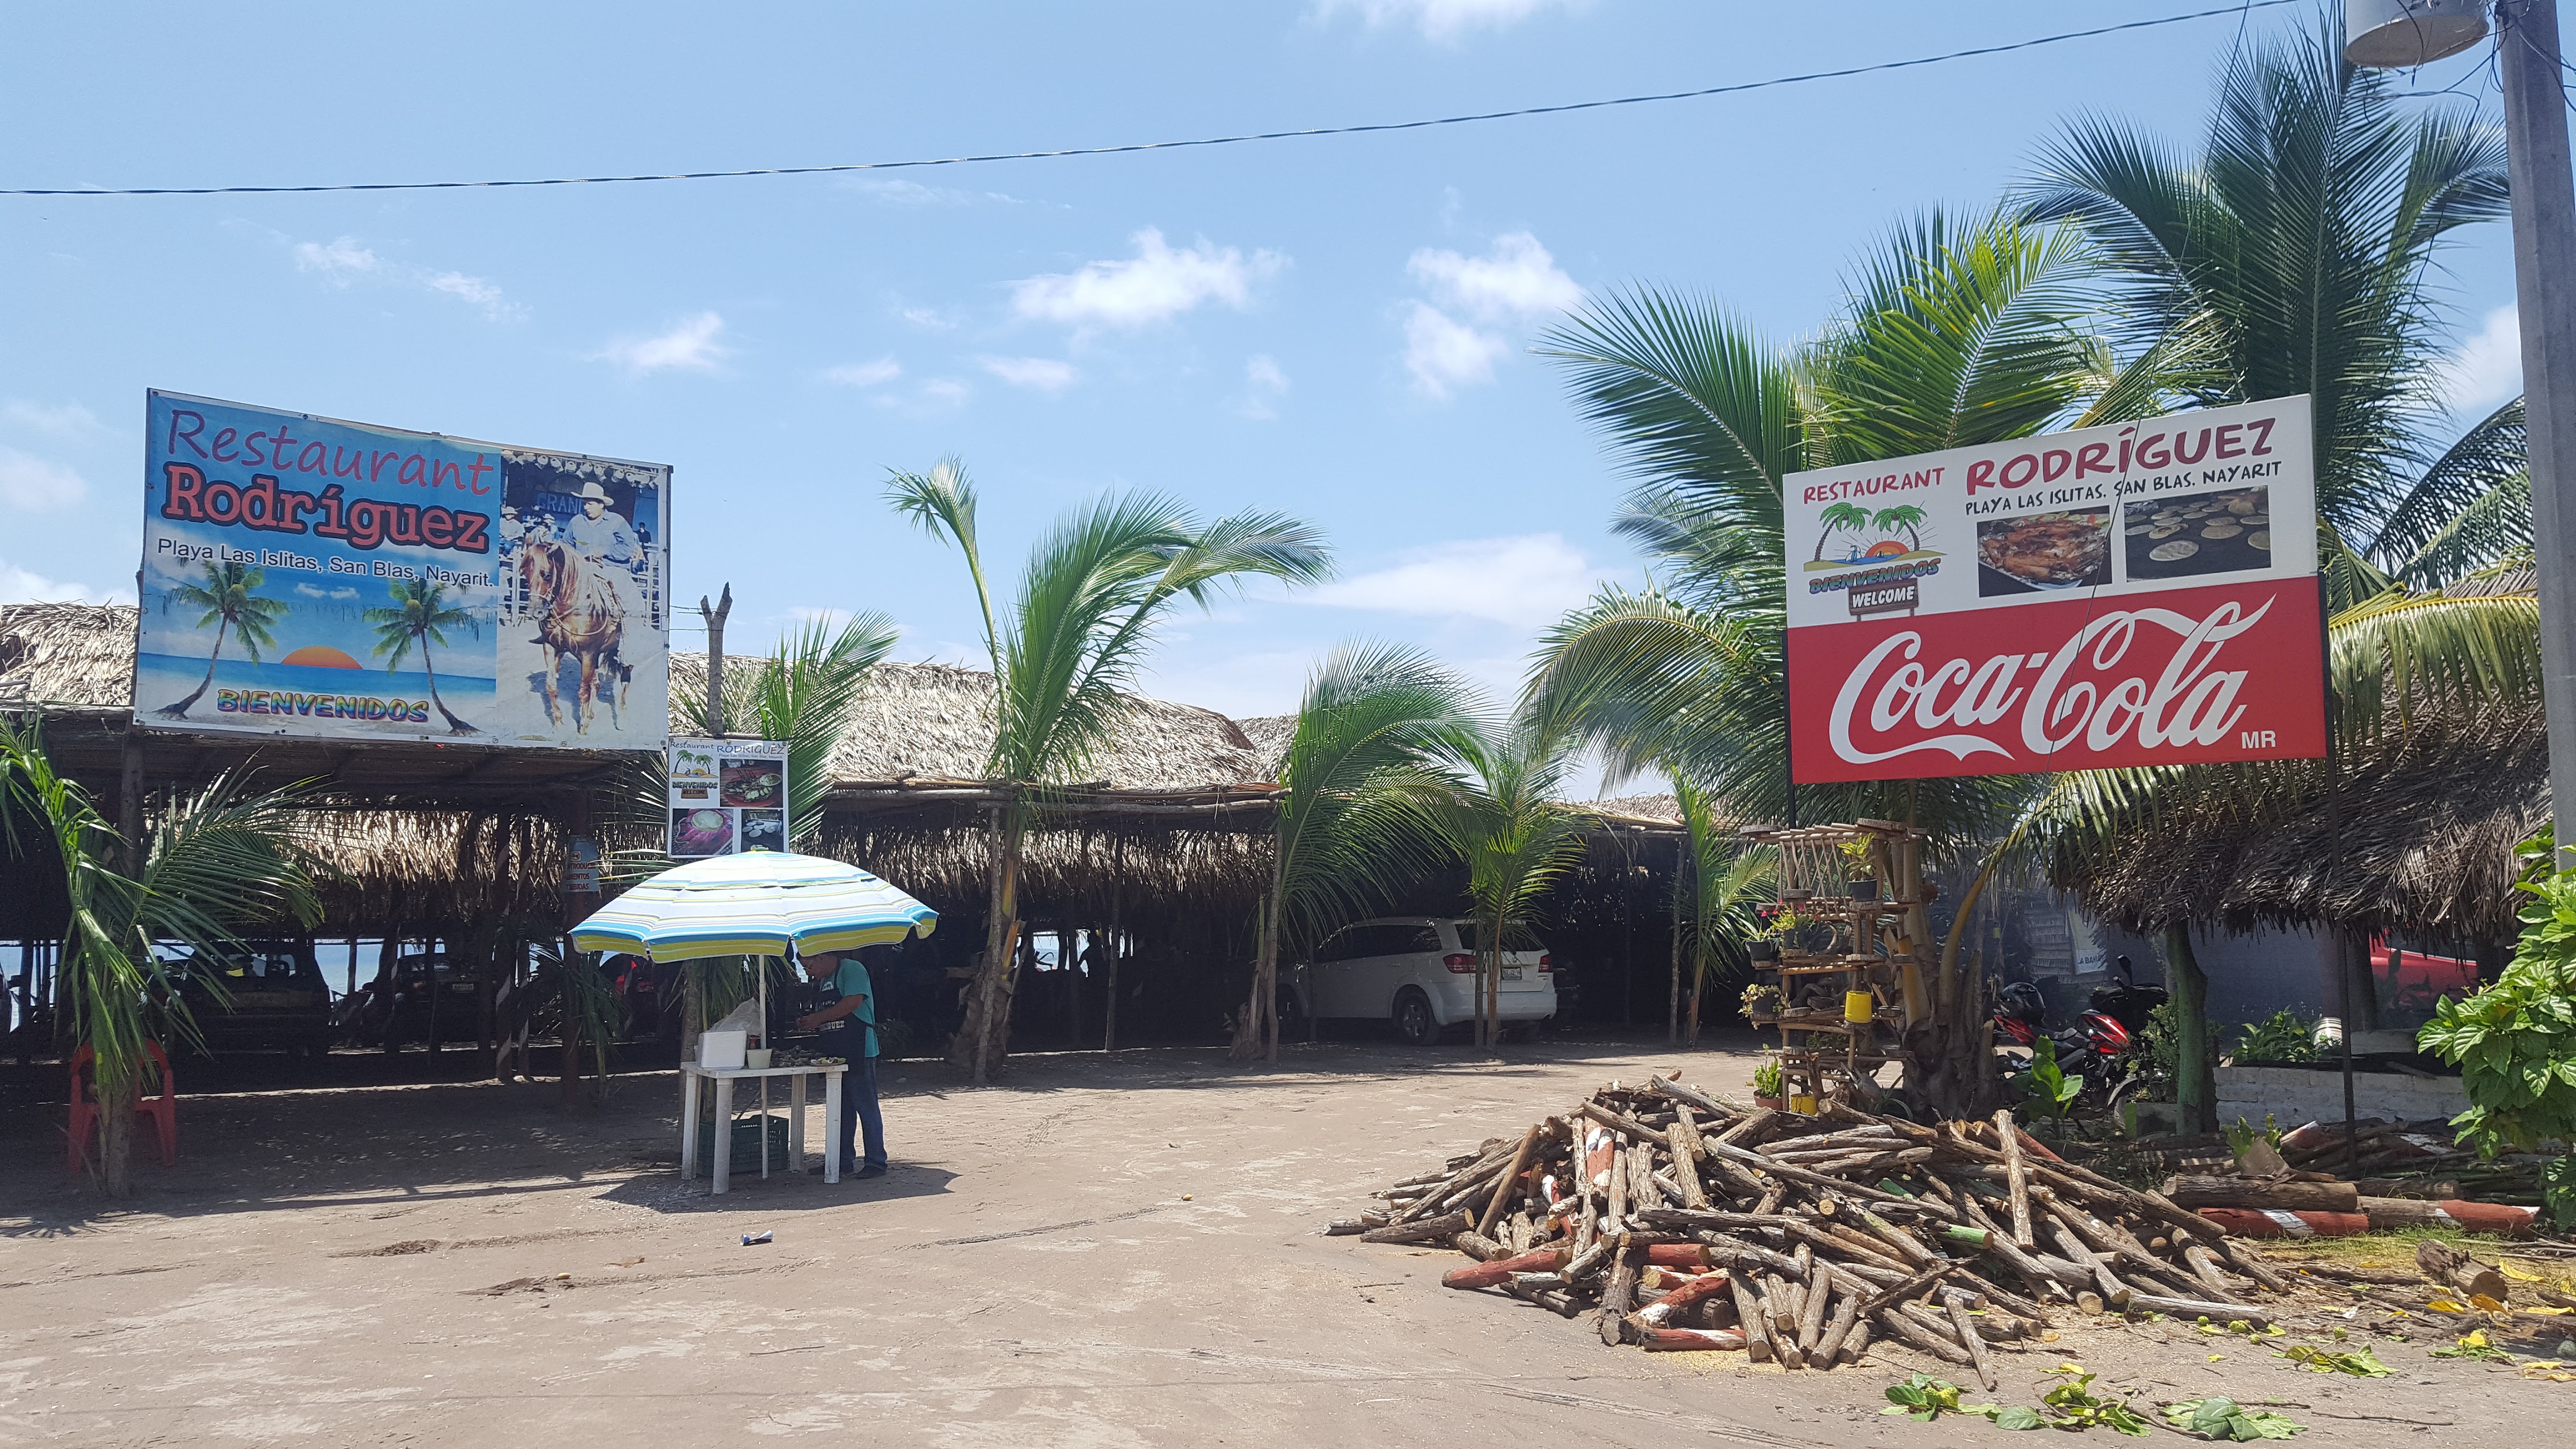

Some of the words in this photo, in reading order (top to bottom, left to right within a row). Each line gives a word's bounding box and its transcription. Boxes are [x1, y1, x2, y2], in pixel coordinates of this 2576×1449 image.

[168, 409, 494, 495] Restaurant
[1966, 417, 2277, 495] RODRÍGUEZ
[1804, 467, 1945, 504] RESTAURANT
[1966, 495, 2011, 516] PLAYA
[2018, 492, 2044, 509] LAS
[2113, 479, 2147, 497] SAN
[2202, 460, 2282, 485] NAYARIT
[162, 462, 489, 553] Rodríguez
[158, 538, 213, 559] Playa
[221, 545, 255, 564] Las
[262, 549, 323, 572] Islitas,
[330, 557, 367, 575] San
[375, 561, 419, 581] Blas,
[426, 565, 494, 588] Nayarit.
[1809, 558, 1942, 595] BIENVENIDOS
[1851, 586, 1915, 609] WELCOME
[1829, 592, 2278, 764] Coca-Cola
[217, 689, 429, 722] BIENVENIDOS
[670, 740, 714, 749] Restaurant
[2242, 730, 2276, 749] MR
